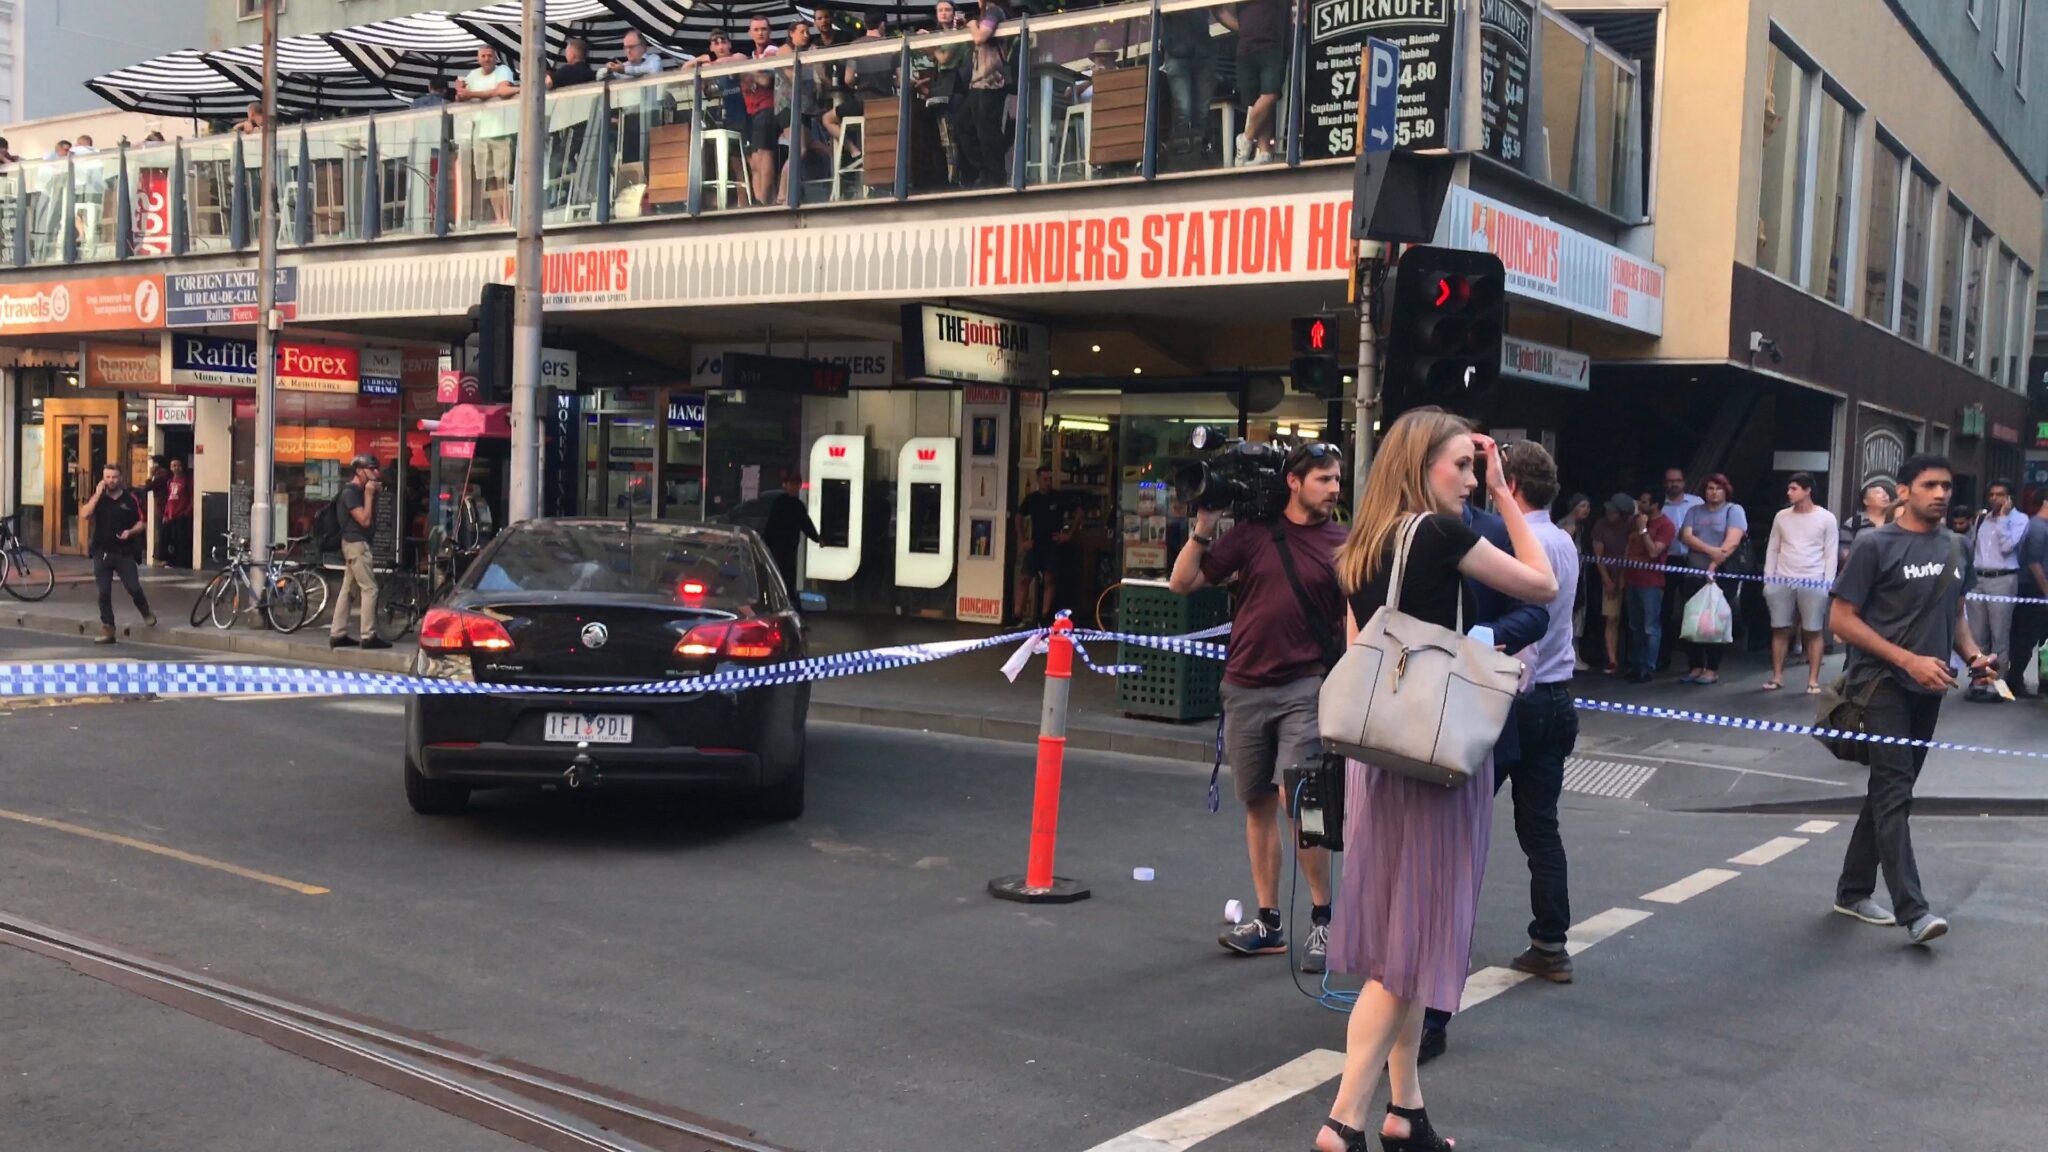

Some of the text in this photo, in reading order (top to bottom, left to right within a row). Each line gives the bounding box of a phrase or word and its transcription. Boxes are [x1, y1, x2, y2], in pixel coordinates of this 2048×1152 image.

[1320, 0, 1435, 31] SMIRNOFF
[1400, 47, 1429, 60] tubbie
[1331, 71, 1357, 99] $7
[1370, 47, 1394, 106] P
[1399, 61, 1437, 88] 4.80
[1328, 127, 1354, 154] $5
[979, 216, 1130, 287] FLINDERS
[1141, 205, 1294, 279] STATION
[1497, 209, 1560, 284] DUNCAN'S
[175, 274, 222, 292] FOREIGN
[4, 296, 50, 319] travels
[206, 307, 253, 322] Raffles Forex
[100, 358, 145, 371] happy
[186, 340, 258, 369] Raffle
[283, 347, 348, 375] Forex
[193, 372, 224, 383] Money
[363, 385, 398, 394] EXCHANGE
[164, 410, 187, 420] OPEN
